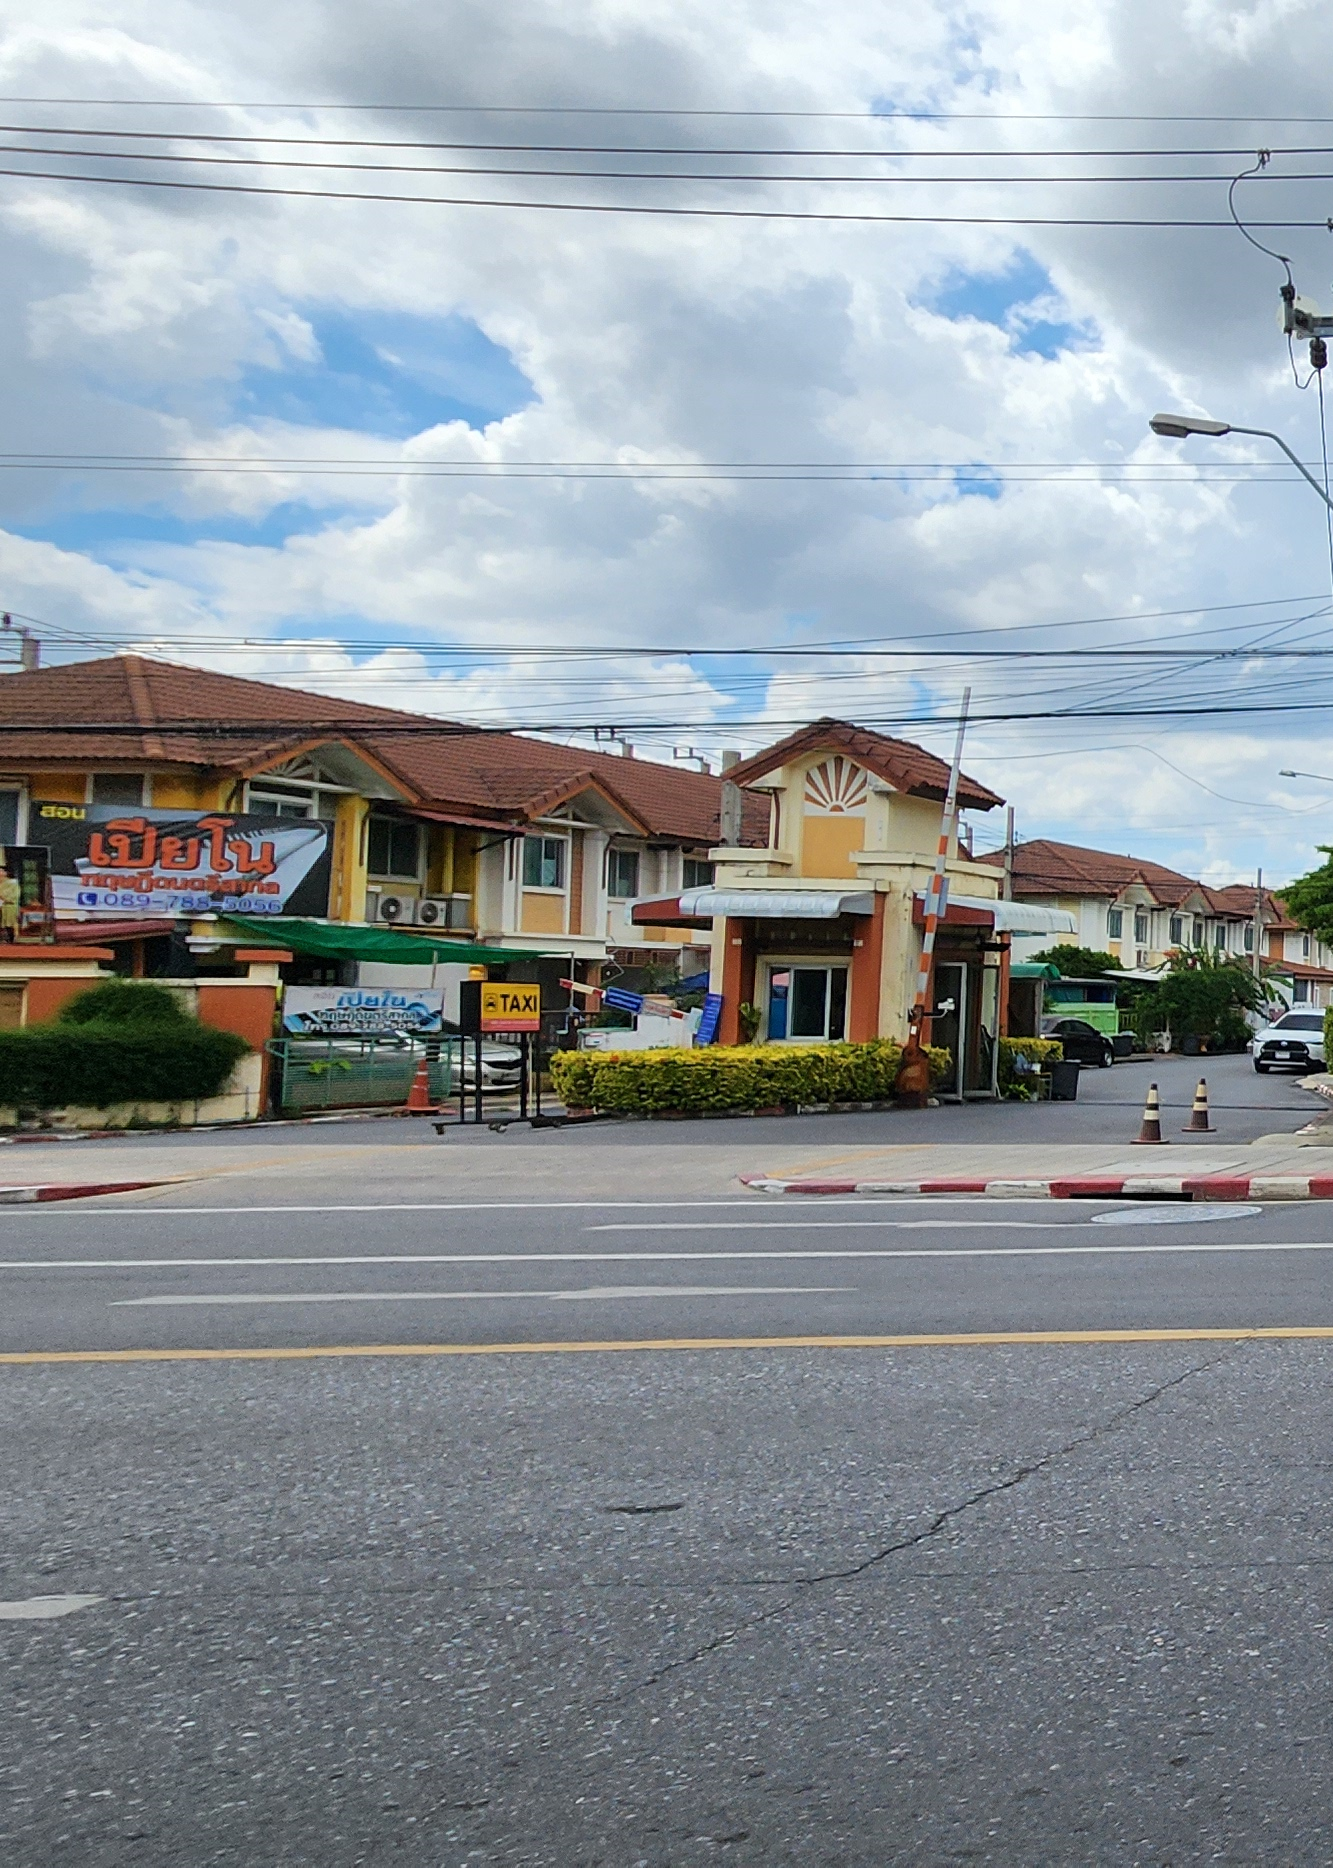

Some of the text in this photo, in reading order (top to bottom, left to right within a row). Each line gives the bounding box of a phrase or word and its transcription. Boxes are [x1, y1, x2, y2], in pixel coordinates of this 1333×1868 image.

[40, 804, 86, 819] สอน
[89, 816, 277, 874] เปียโน
[499, 993, 538, 1013] TAXI
